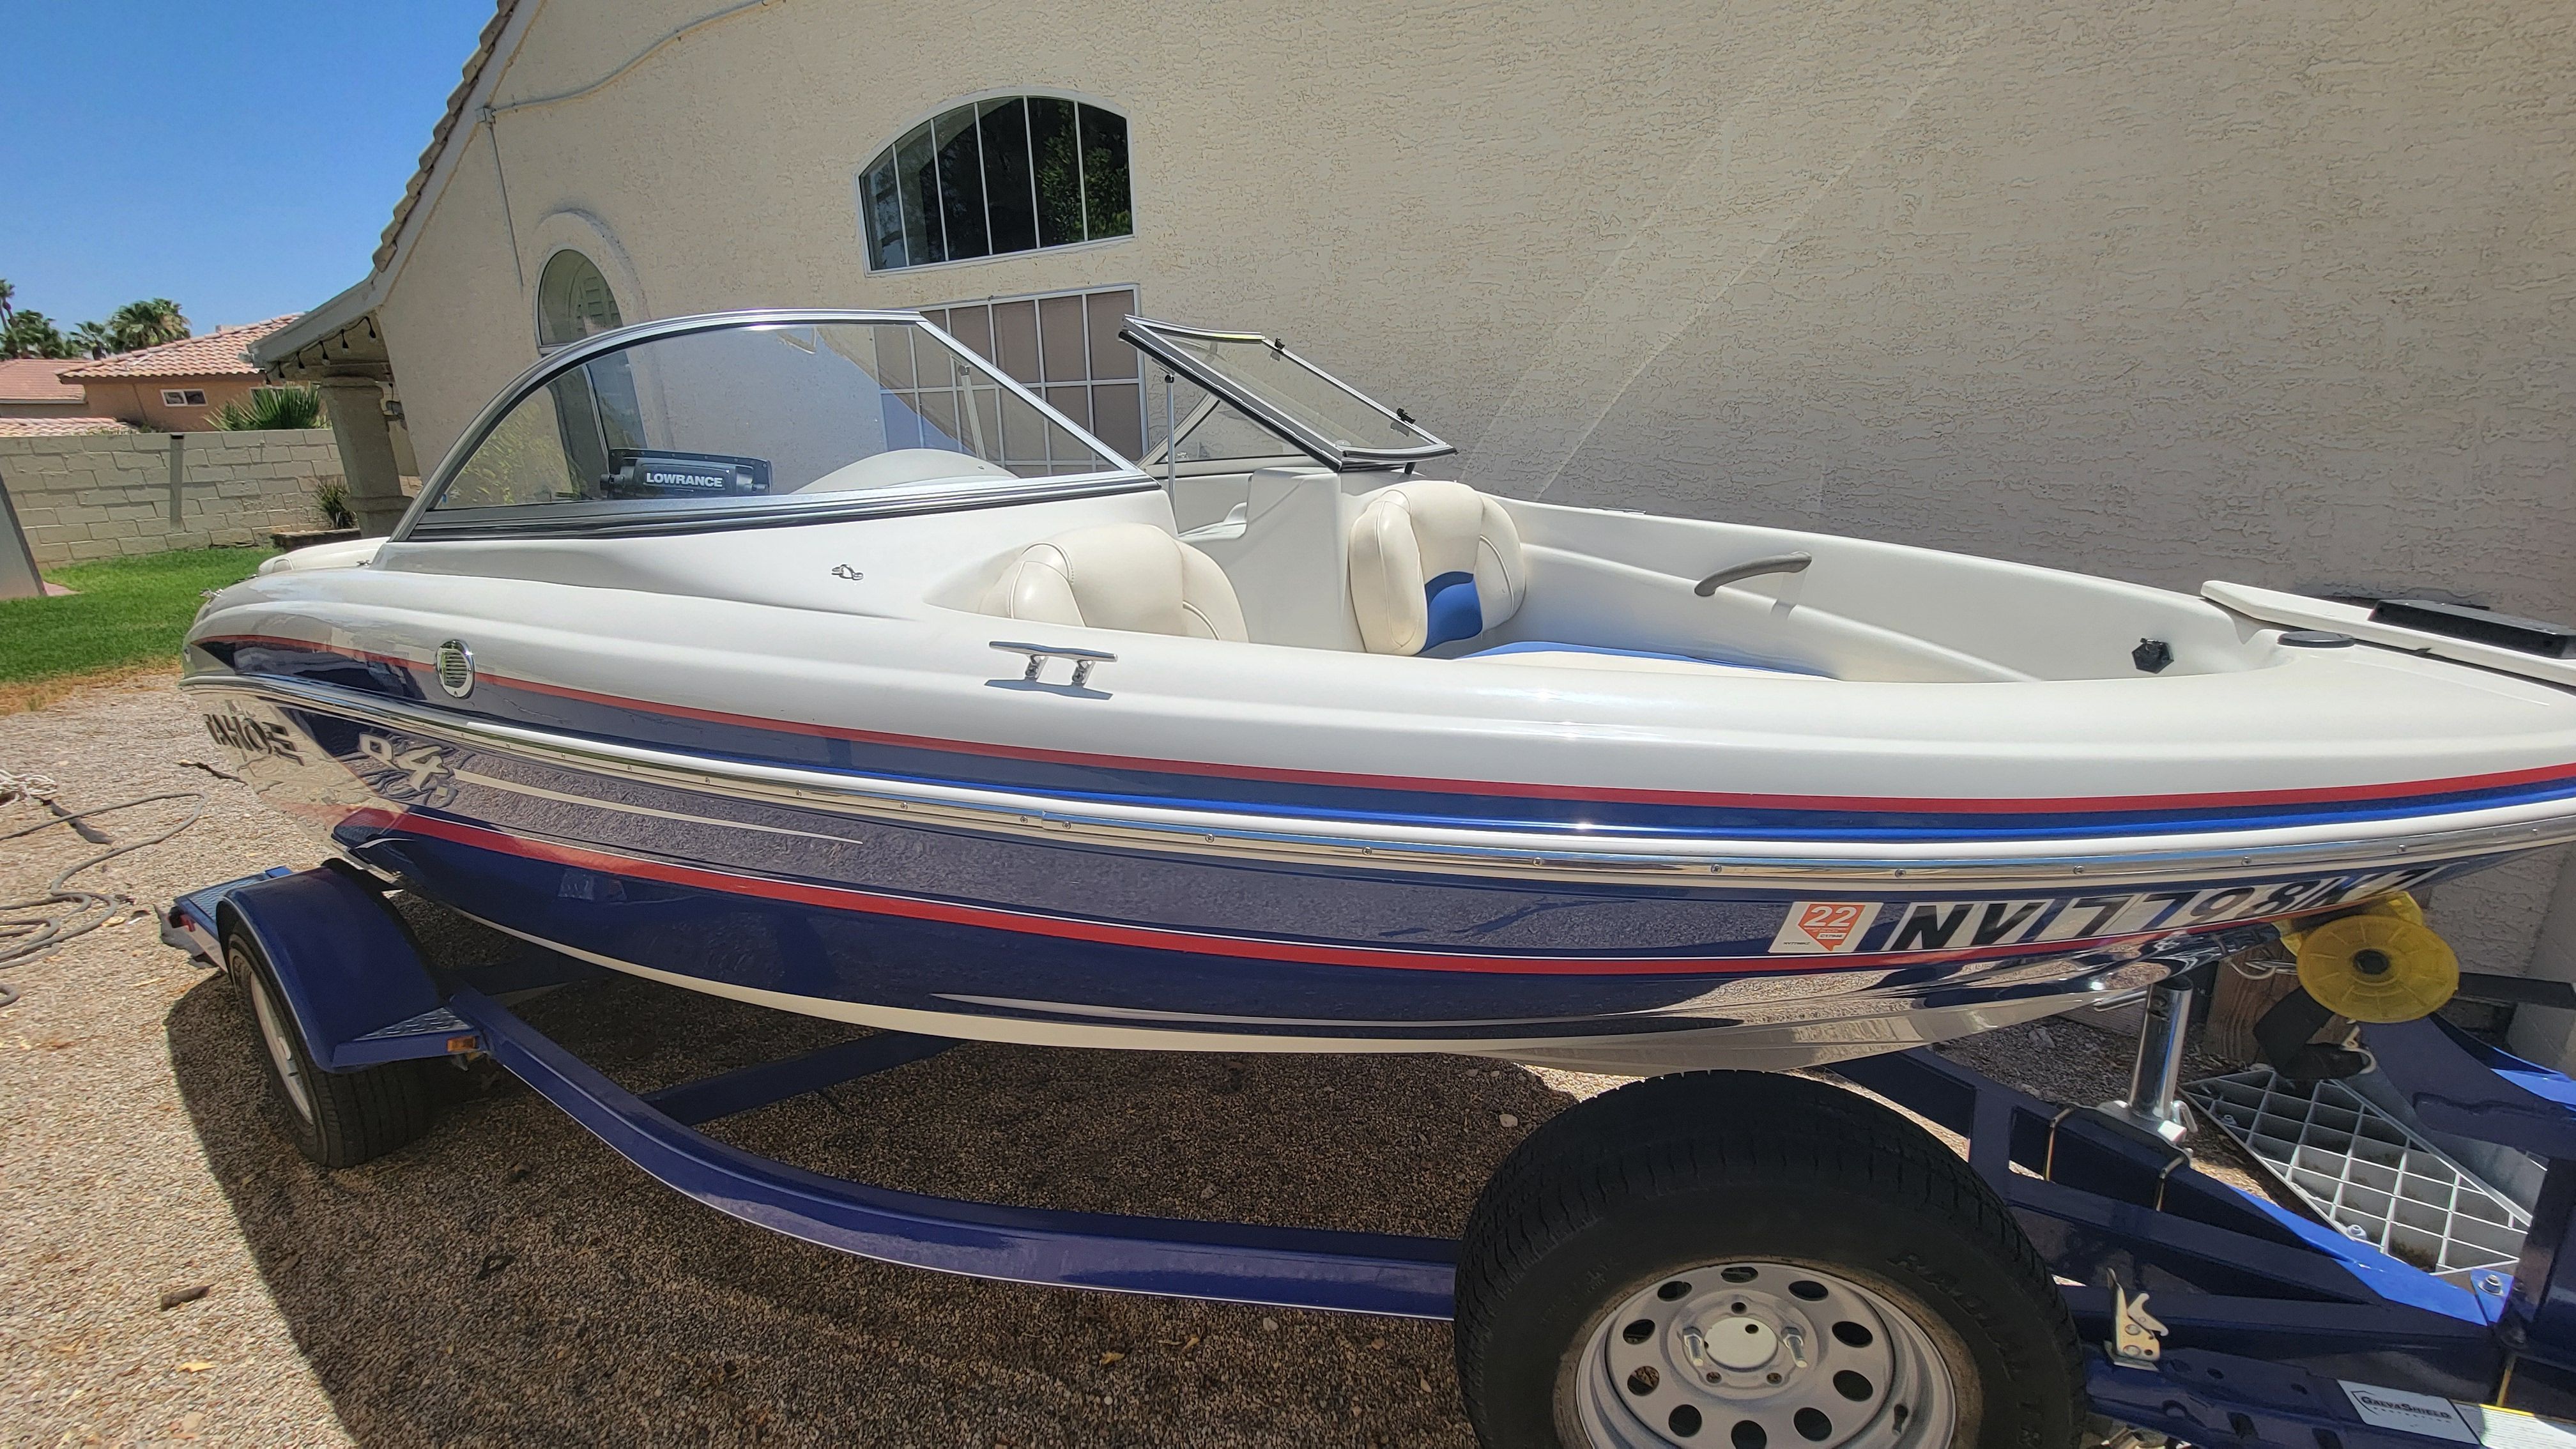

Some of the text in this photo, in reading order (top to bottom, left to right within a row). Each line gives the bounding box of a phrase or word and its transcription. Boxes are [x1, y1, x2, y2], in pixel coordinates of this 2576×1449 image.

[646, 472, 723, 488] LOWRANCE
[202, 714, 305, 767] TAHOE
[1804, 906, 1857, 927] 22
